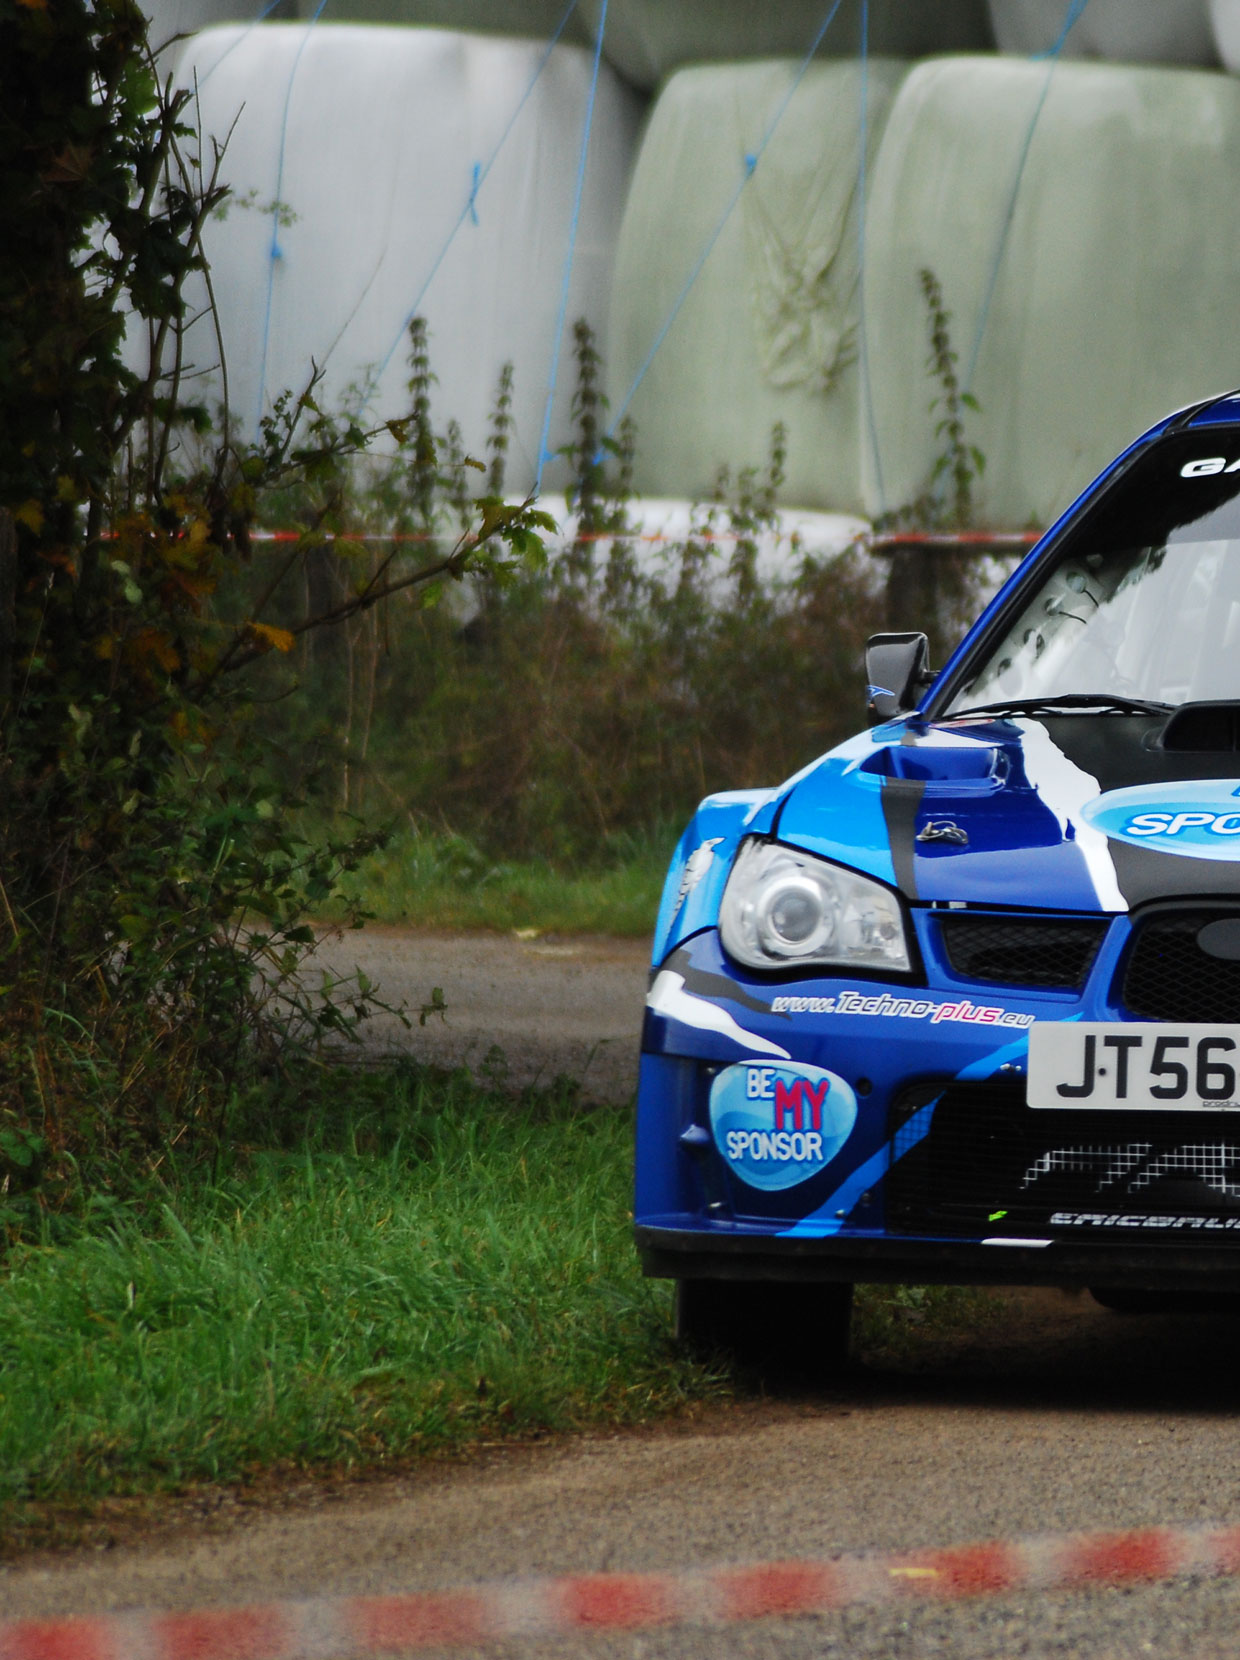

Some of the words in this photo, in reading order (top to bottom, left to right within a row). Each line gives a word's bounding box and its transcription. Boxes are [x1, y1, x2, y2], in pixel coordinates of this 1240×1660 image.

[771, 991, 1035, 1028] www.Techno-plus.eu
[747, 1069, 776, 1099] BE
[1056, 1034, 1236, 1100] JT56
[774, 1078, 830, 1131] MY
[726, 1131, 824, 1161] SPONSOR
